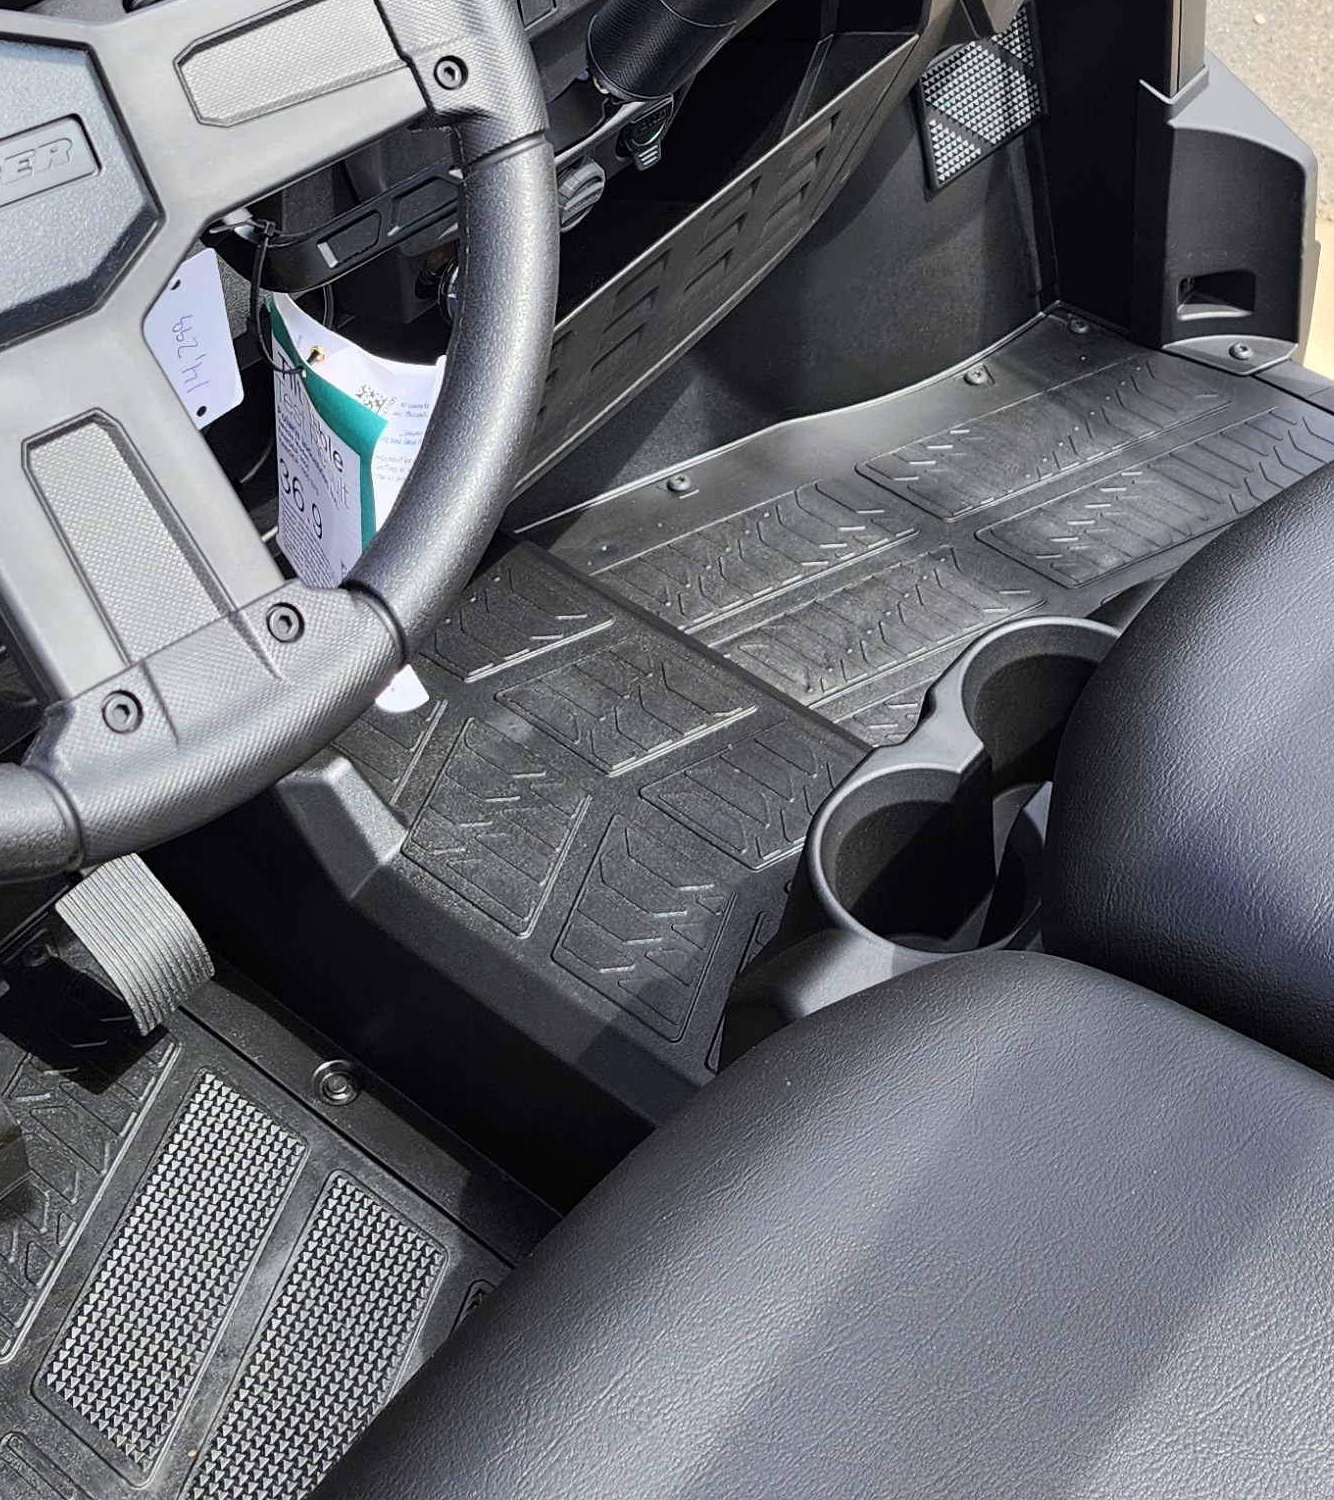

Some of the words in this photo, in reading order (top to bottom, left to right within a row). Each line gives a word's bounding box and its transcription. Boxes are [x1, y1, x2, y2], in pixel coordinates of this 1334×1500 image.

[172, 313, 211, 394] 14,299
[278, 350, 303, 405] Tilt
[276, 374, 307, 435] Test
[280, 458, 323, 540] 36.9
